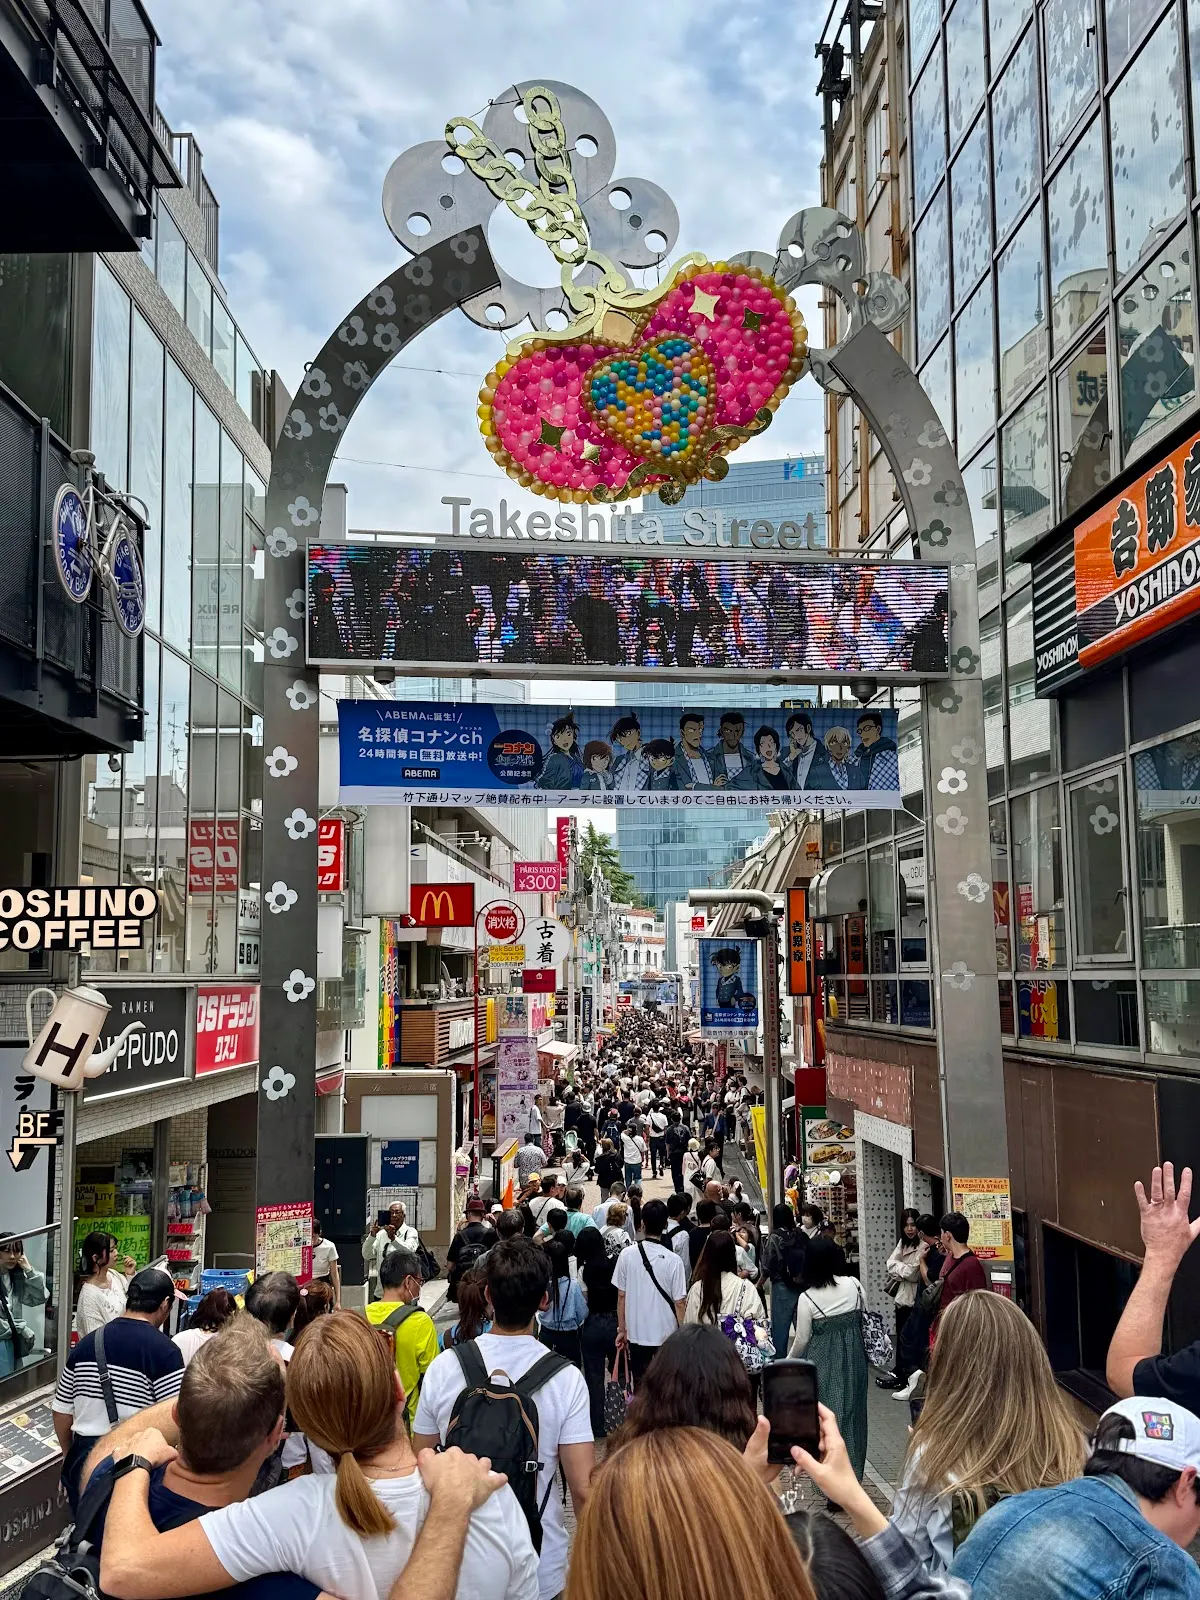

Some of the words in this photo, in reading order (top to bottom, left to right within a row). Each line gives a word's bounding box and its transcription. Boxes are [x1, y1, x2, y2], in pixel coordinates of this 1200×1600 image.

[441, 496, 666, 544] Takeshita
[683, 507, 821, 551] Street
[358, 727, 483, 745] 名探偵コナンch
[404, 769, 437, 778] ABEMA
[403, 791, 548, 805] 竹下通りマップ絶賛配布中!
[557, 794, 854, 806] アーチに設置していますのでご自由にお持ち帰りください。
[318, 845, 337, 867] S
[519, 875, 556, 890] ¥300
[487, 916, 515, 930] 消火栓
[536, 920, 556, 963] 古着
[791, 920, 803, 962] 吉野家
[121, 1000, 154, 1014] RAMEN
[35, 1021, 90, 1077] H
[214, 1034, 239, 1063] クスリ
[19, 1113, 50, 1137] BF
